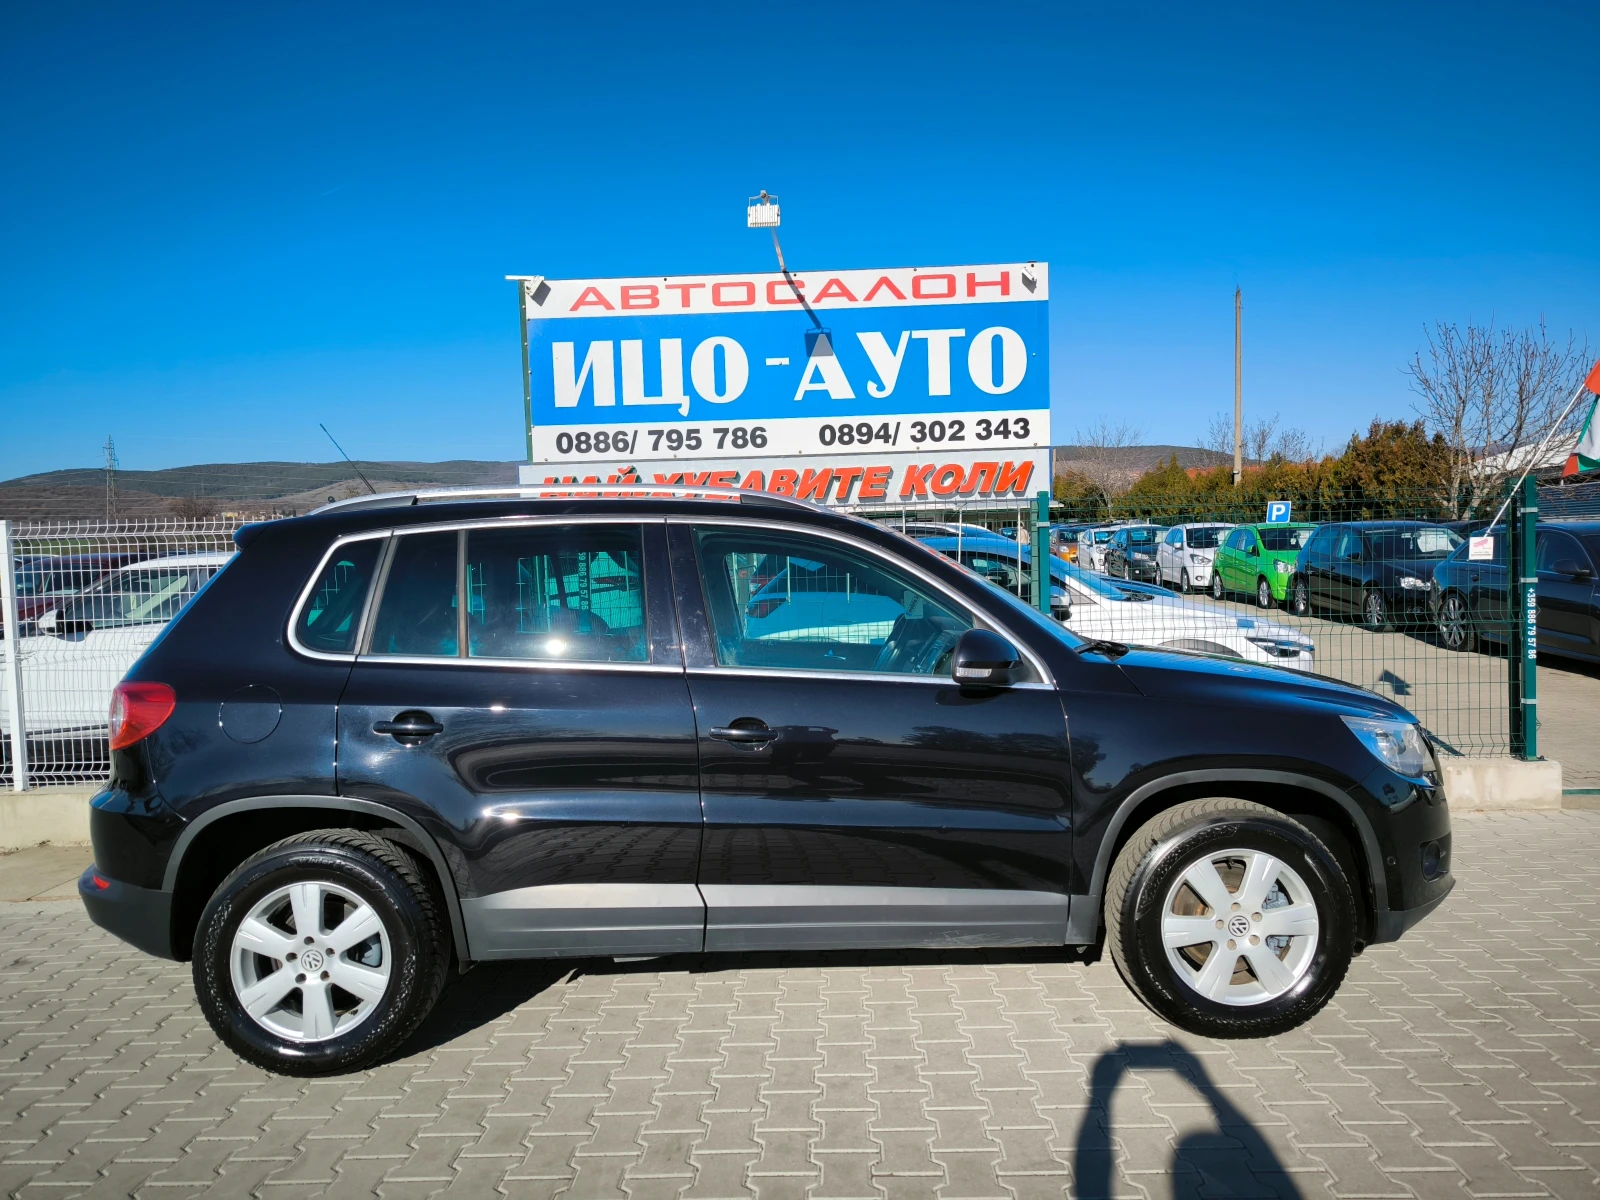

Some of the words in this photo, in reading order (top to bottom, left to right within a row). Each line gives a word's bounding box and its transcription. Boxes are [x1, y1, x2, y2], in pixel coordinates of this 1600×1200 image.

[571, 271, 1010, 311] АВТОСАЛОН
[555, 430, 638, 455] 0886/
[647, 429, 702, 452] 795
[712, 427, 768, 450] 786
[818, 422, 901, 446] 0894/
[910, 420, 965, 443] 302
[975, 418, 1031, 441] 343
[900, 461, 1034, 497] КОЛИ
[1527, 588, 1536, 607] +359
[1527, 609, 1536, 624] 886
[1527, 625, 1536, 636] 79
[1527, 637, 1536, 648] 57
[1527, 649, 1537, 659] 86
